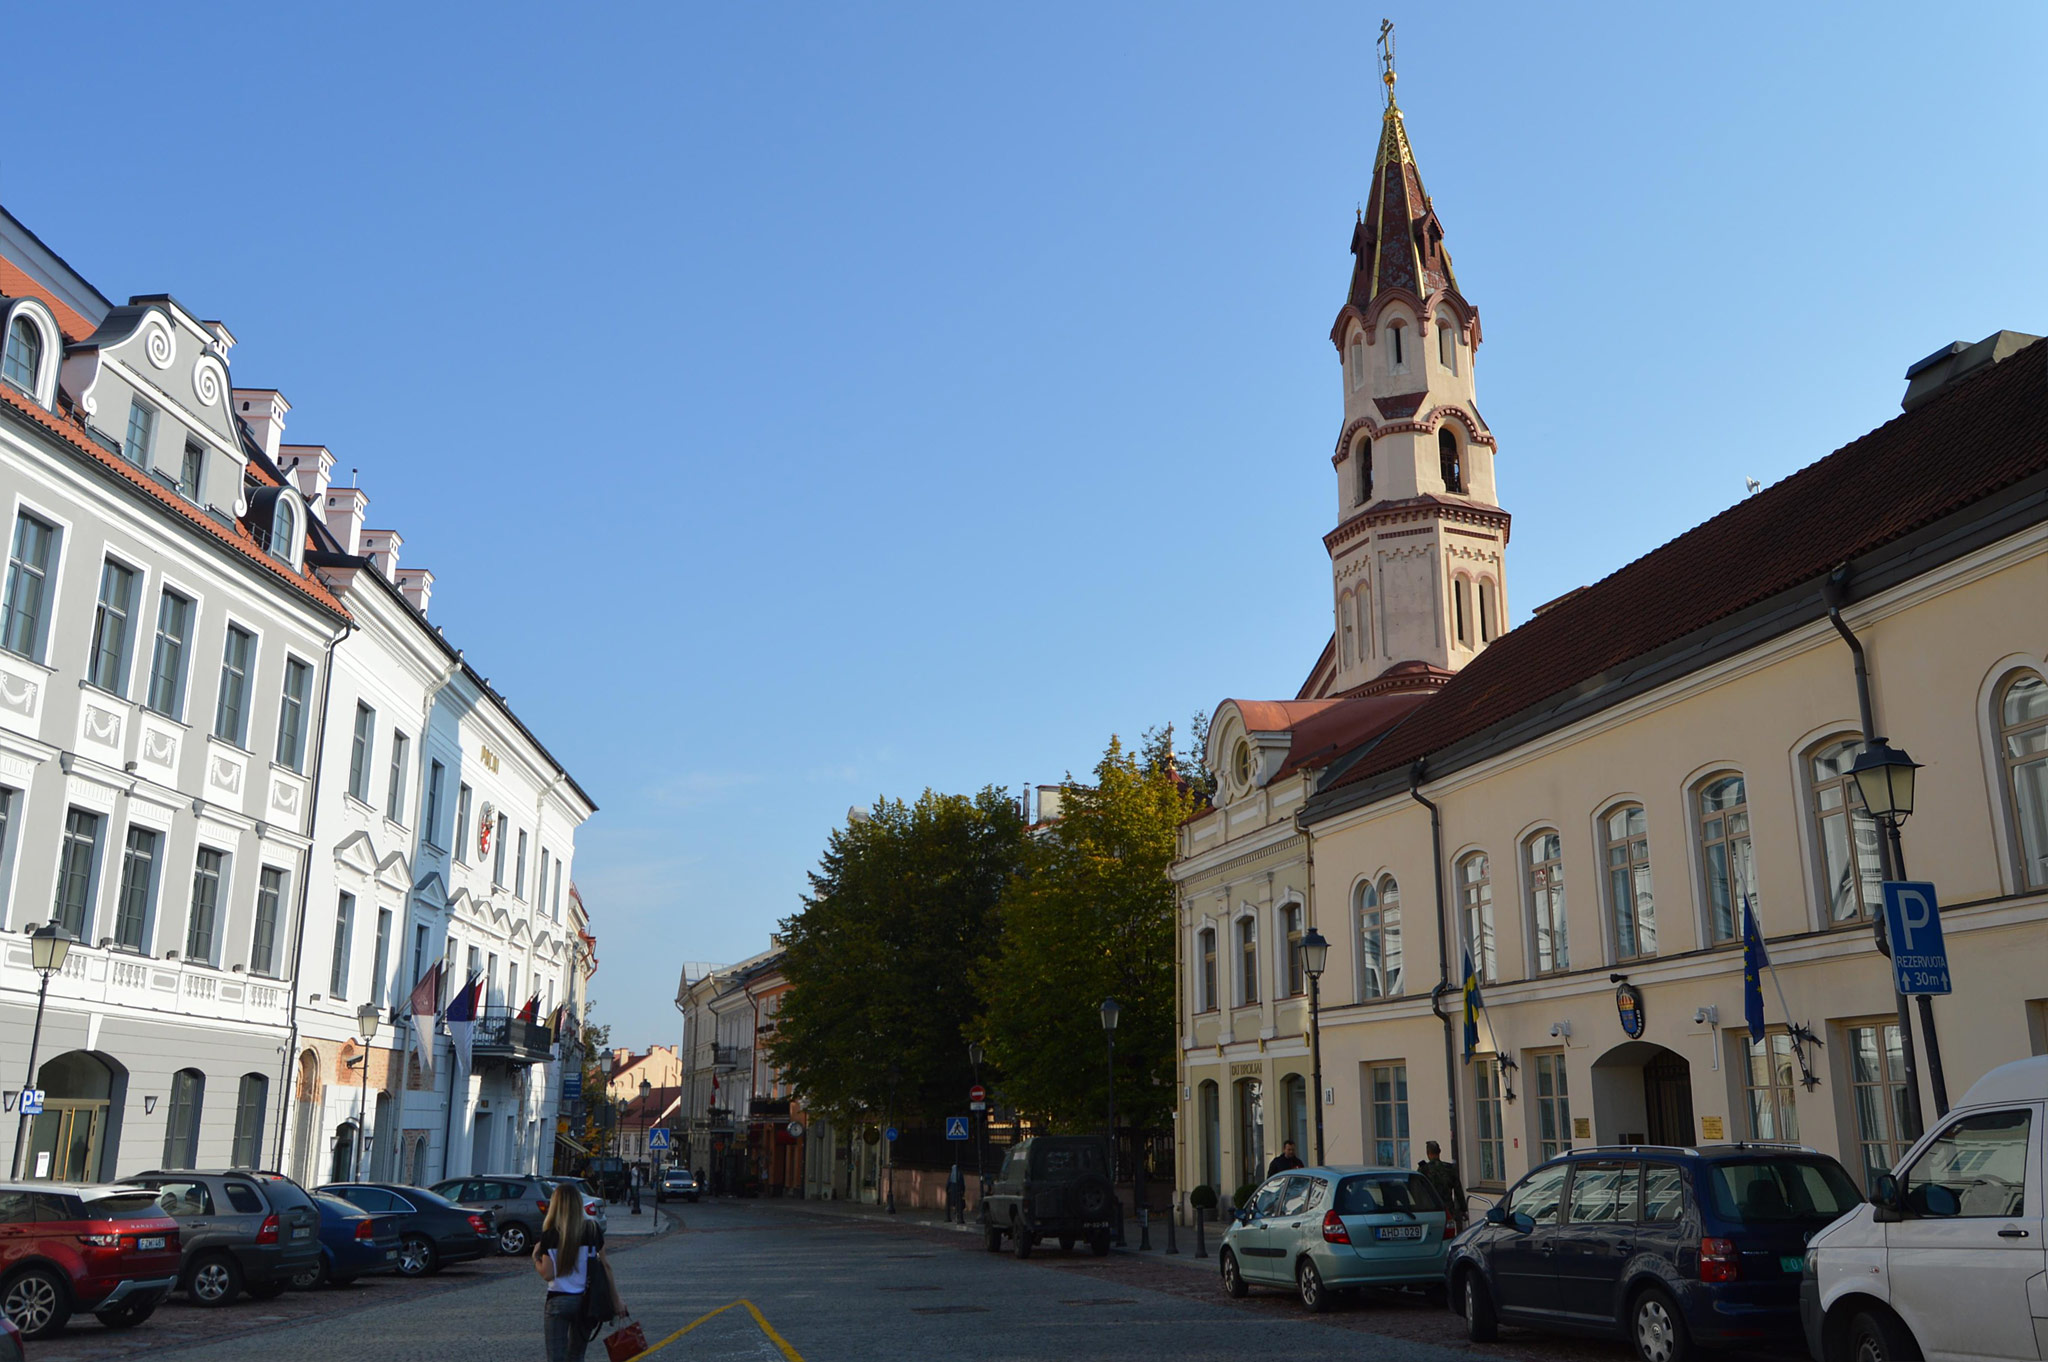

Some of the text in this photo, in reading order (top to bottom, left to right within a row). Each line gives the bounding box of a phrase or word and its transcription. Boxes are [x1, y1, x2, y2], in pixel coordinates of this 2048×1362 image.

[1897, 890, 1930, 951] P
[1896, 955, 1947, 968] REZERVUOTA
[1914, 971, 1940, 986] 30m
[21, 1090, 33, 1113] P
[1381, 1226, 1420, 1237] AHD 029
